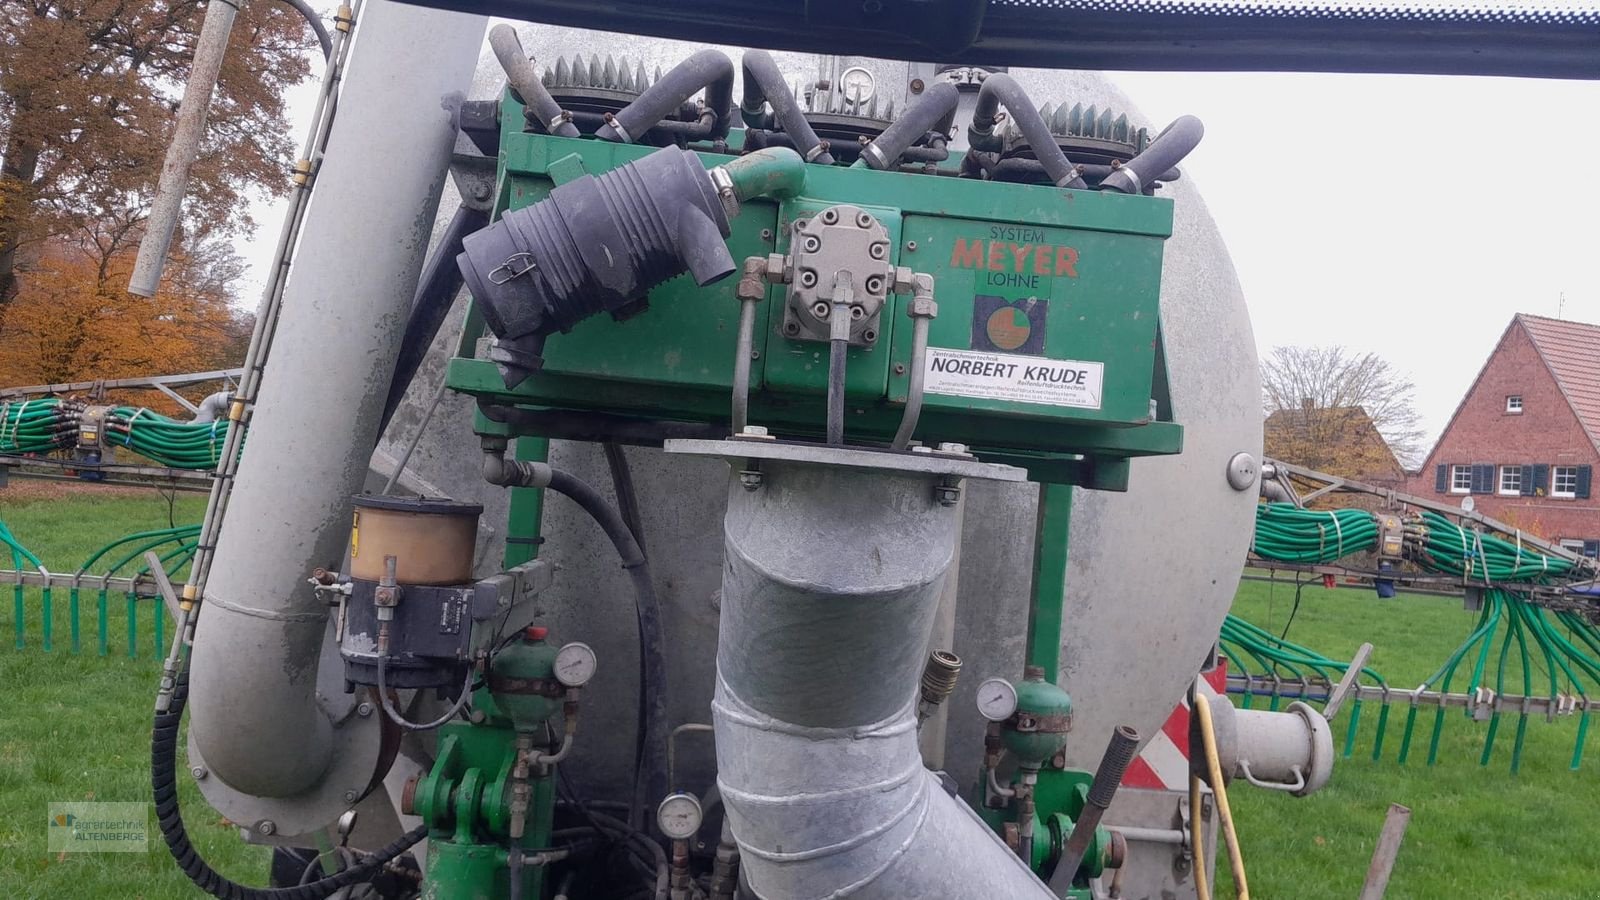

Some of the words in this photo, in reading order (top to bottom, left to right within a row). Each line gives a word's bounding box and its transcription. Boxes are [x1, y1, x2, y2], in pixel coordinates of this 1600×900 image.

[990, 226, 1045, 243] SYSTEM
[951, 238, 1079, 277] MEYER
[987, 272, 1039, 288] LOHNE
[932, 350, 999, 362] Zentralschmiertechnik
[931, 357, 1018, 378] NORBERT
[1023, 365, 1088, 385] KRUDE
